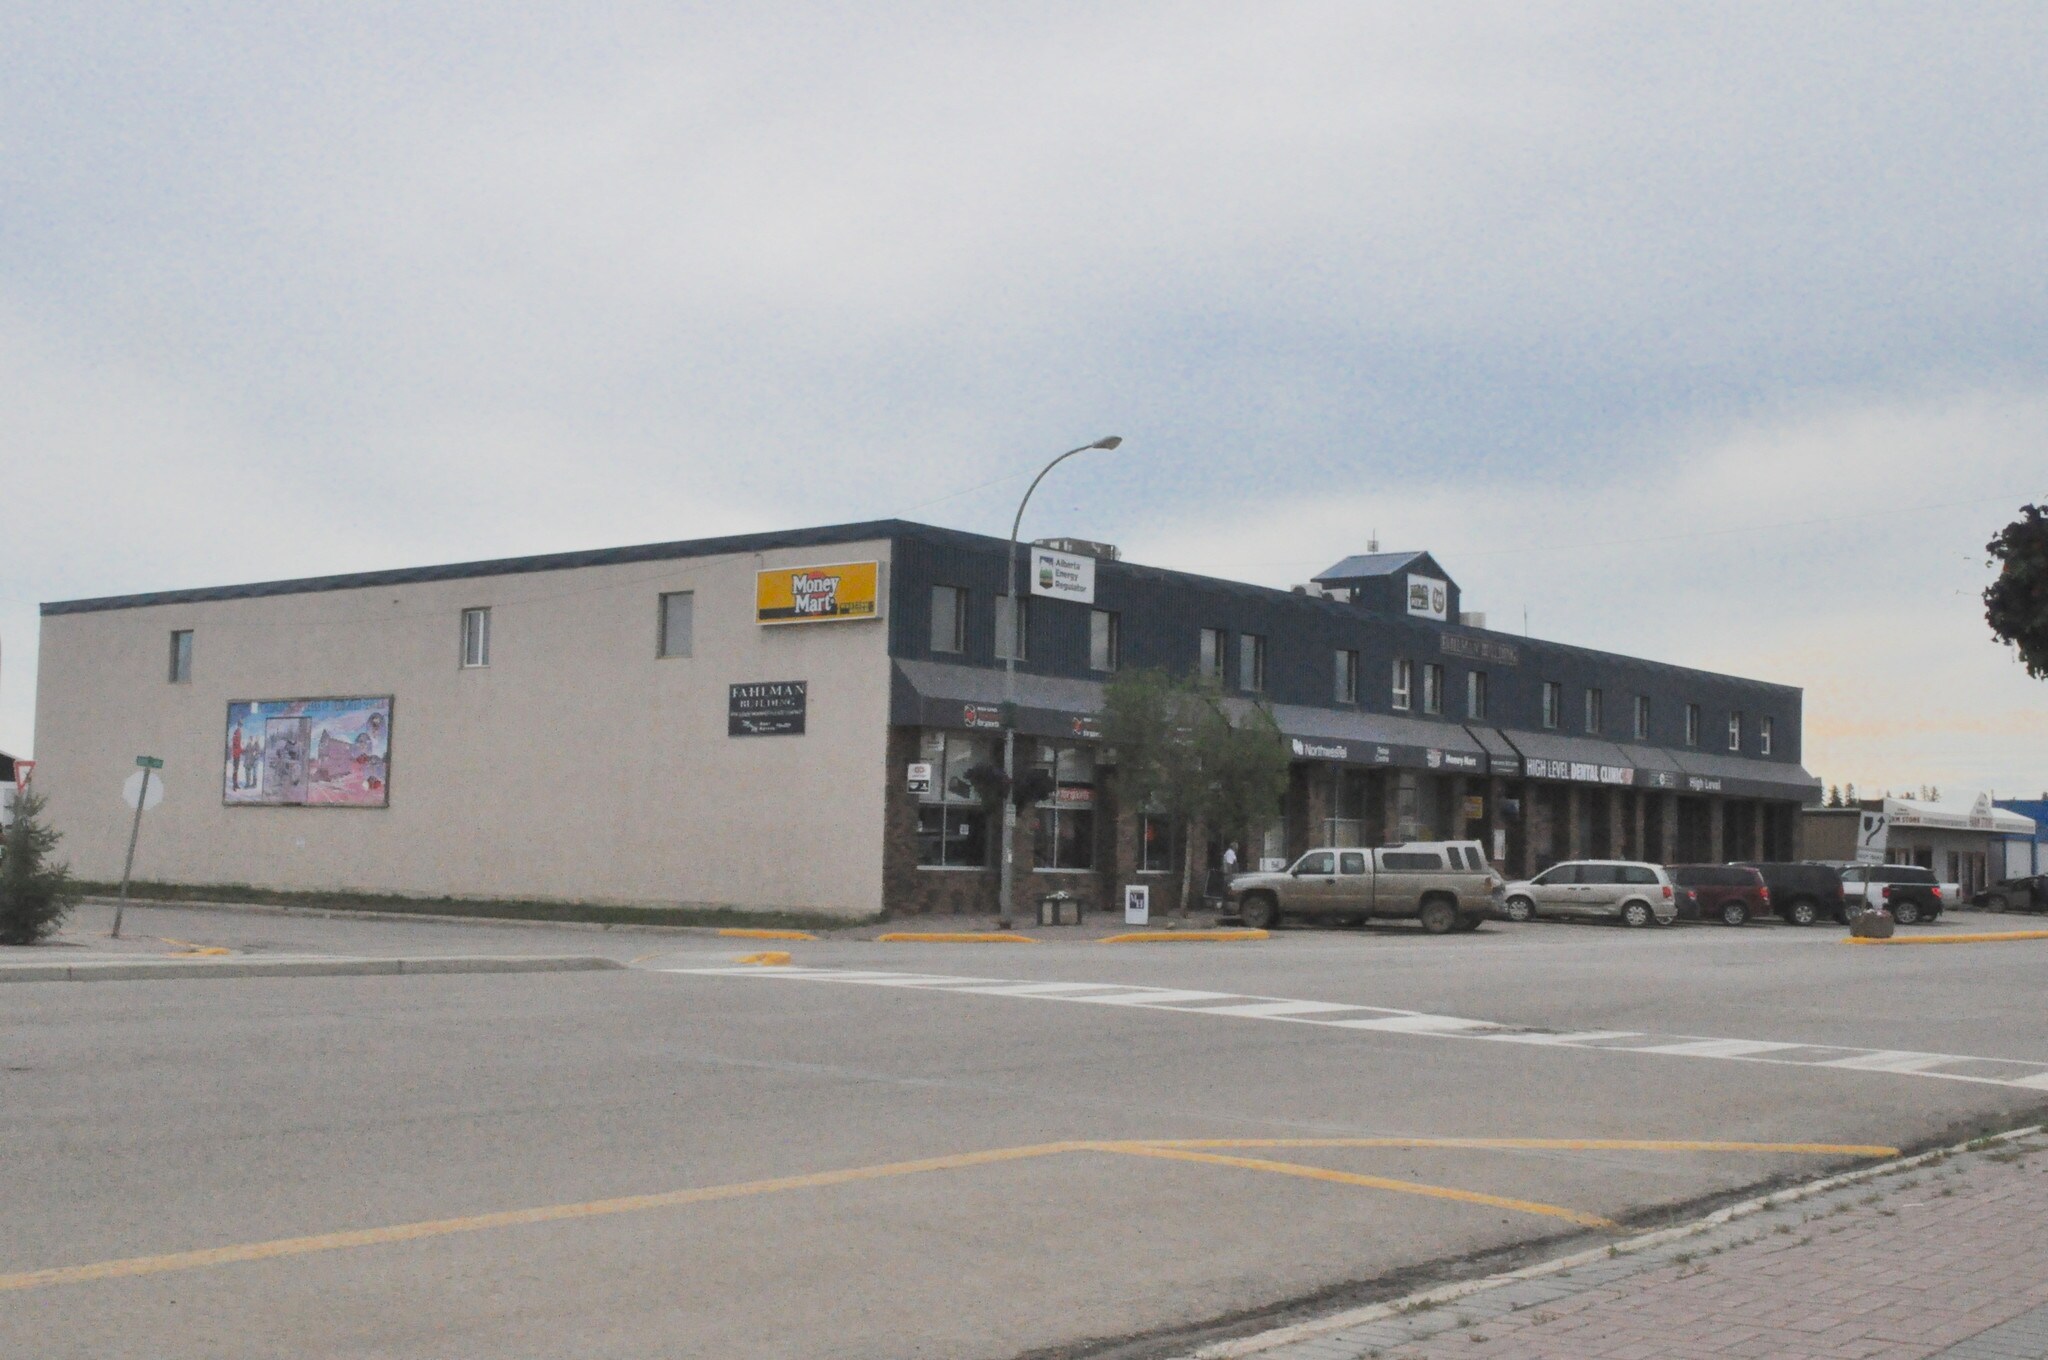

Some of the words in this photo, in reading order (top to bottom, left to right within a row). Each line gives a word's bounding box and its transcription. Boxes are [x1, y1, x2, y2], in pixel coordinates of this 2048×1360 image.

[1056, 559, 1080, 570] Alberta
[1055, 569, 1078, 582] Energy
[792, 574, 840, 596] Money
[1055, 581, 1087, 592] Regulator
[795, 594, 832, 613] Mart
[732, 685, 805, 698] FAHLMAN
[1526, 758, 1546, 777] HIGH
[1547, 760, 1569, 780] LEVEL
[1570, 763, 1599, 782] DENTAL
